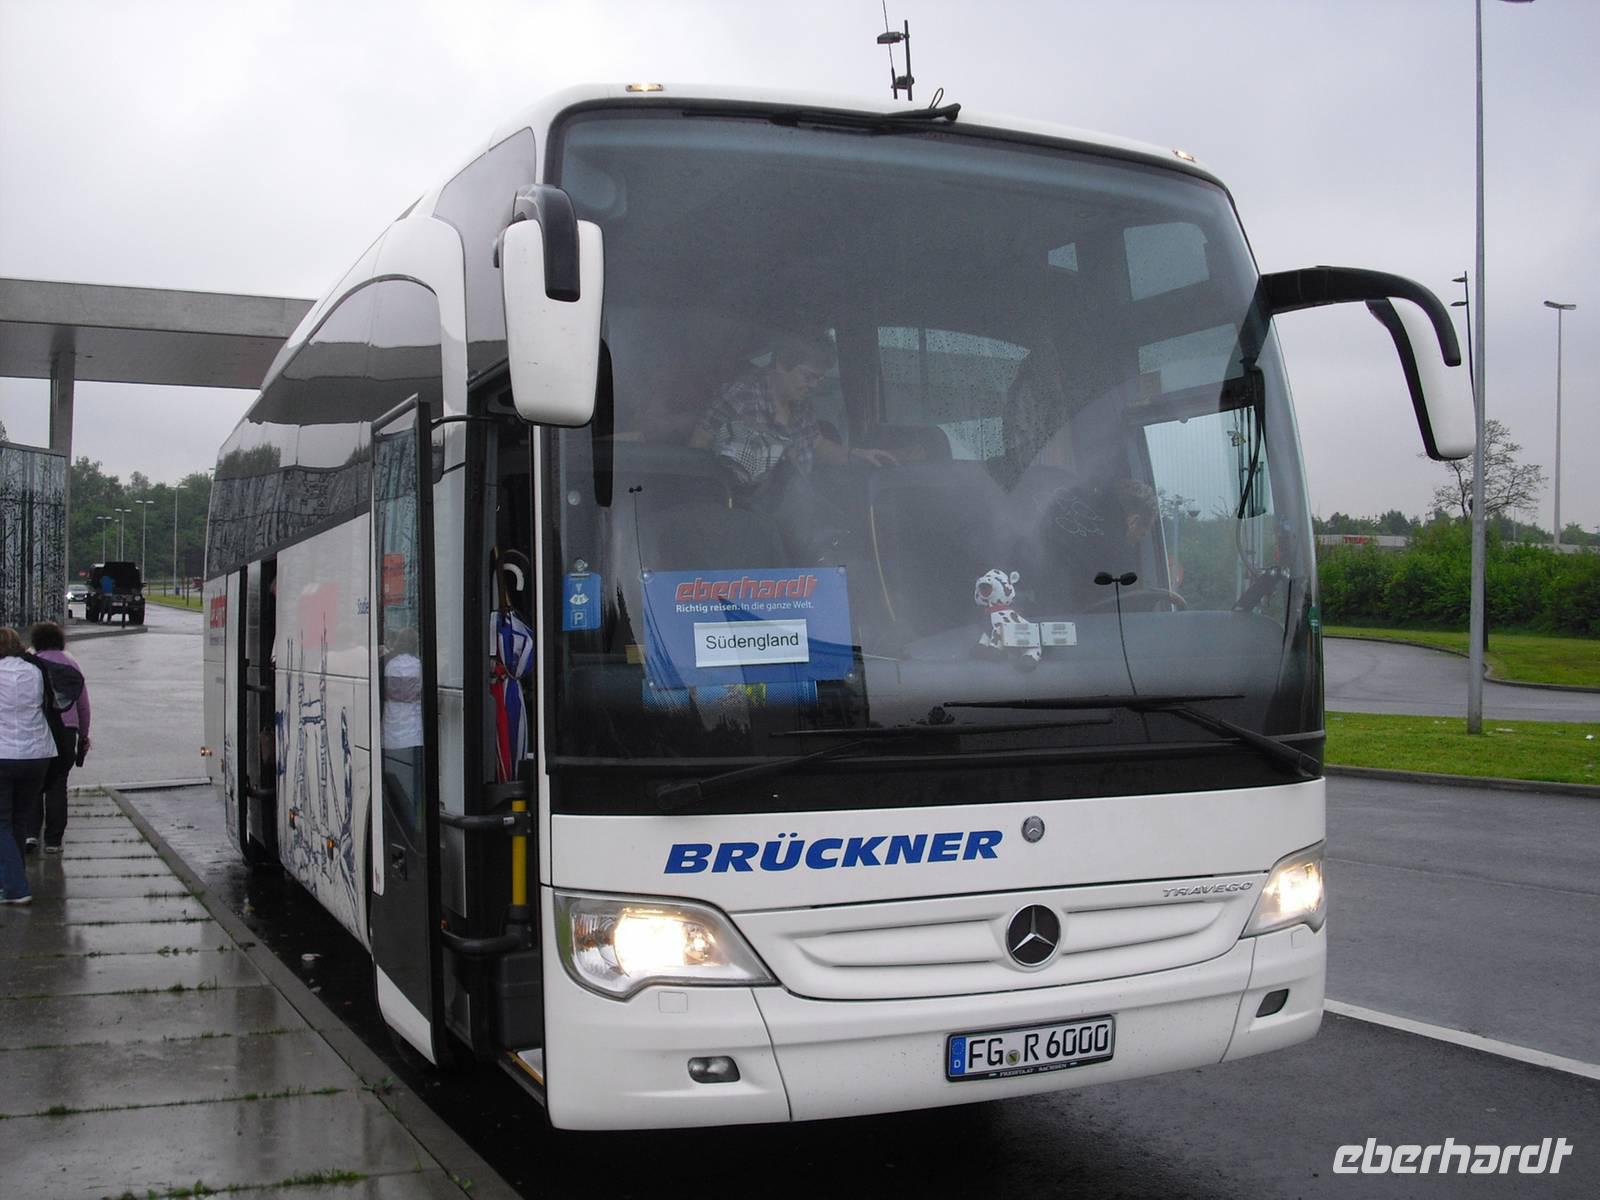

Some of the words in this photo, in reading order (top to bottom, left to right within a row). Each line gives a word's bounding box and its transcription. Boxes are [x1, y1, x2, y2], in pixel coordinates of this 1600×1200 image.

[675, 575, 817, 602] eberhardt
[675, 603, 708, 614] Richtig
[710, 603, 741, 612] reisen.
[751, 601, 765, 610] die
[766, 602, 792, 612] ganze
[793, 600, 814, 610] Welt.
[705, 632, 799, 651] Südengland
[663, 830, 1004, 874] BRÜCKNER
[1162, 881, 1254, 898] TRAVEGO
[968, 1037, 1004, 1069] FG
[1023, 1033, 1039, 1062] R
[1046, 1023, 1109, 1059] 6000
